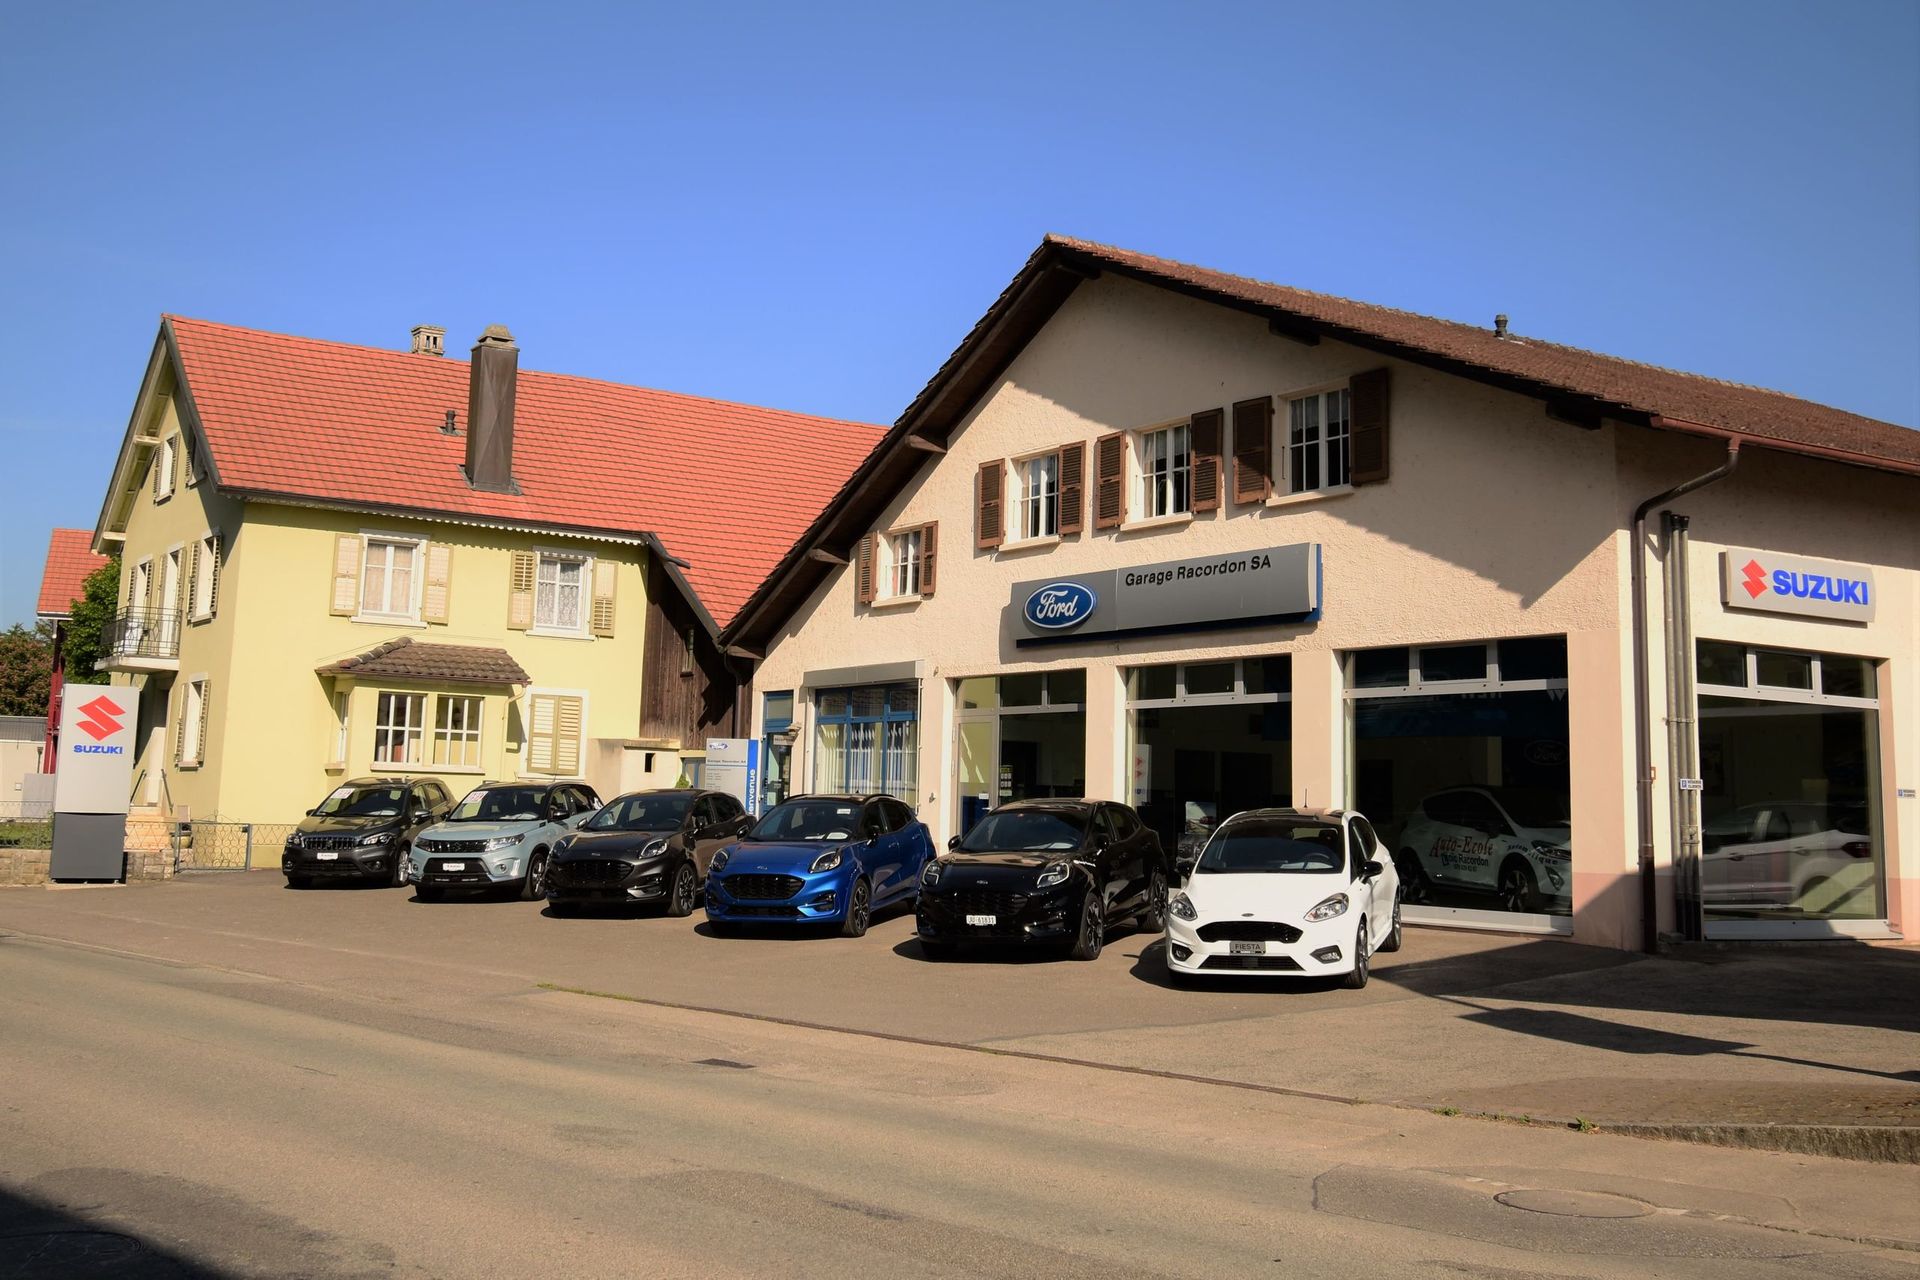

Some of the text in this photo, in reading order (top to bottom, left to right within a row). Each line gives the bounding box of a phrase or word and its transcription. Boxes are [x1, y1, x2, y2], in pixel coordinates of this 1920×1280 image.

[1125, 554, 1271, 587] Garage Racordon SA
[1036, 589, 1078, 619] Ford
[1772, 569, 1869, 606] SUZUKI
[73, 744, 123, 755] SUZUKI
[748, 768, 756, 815] ienvenue
